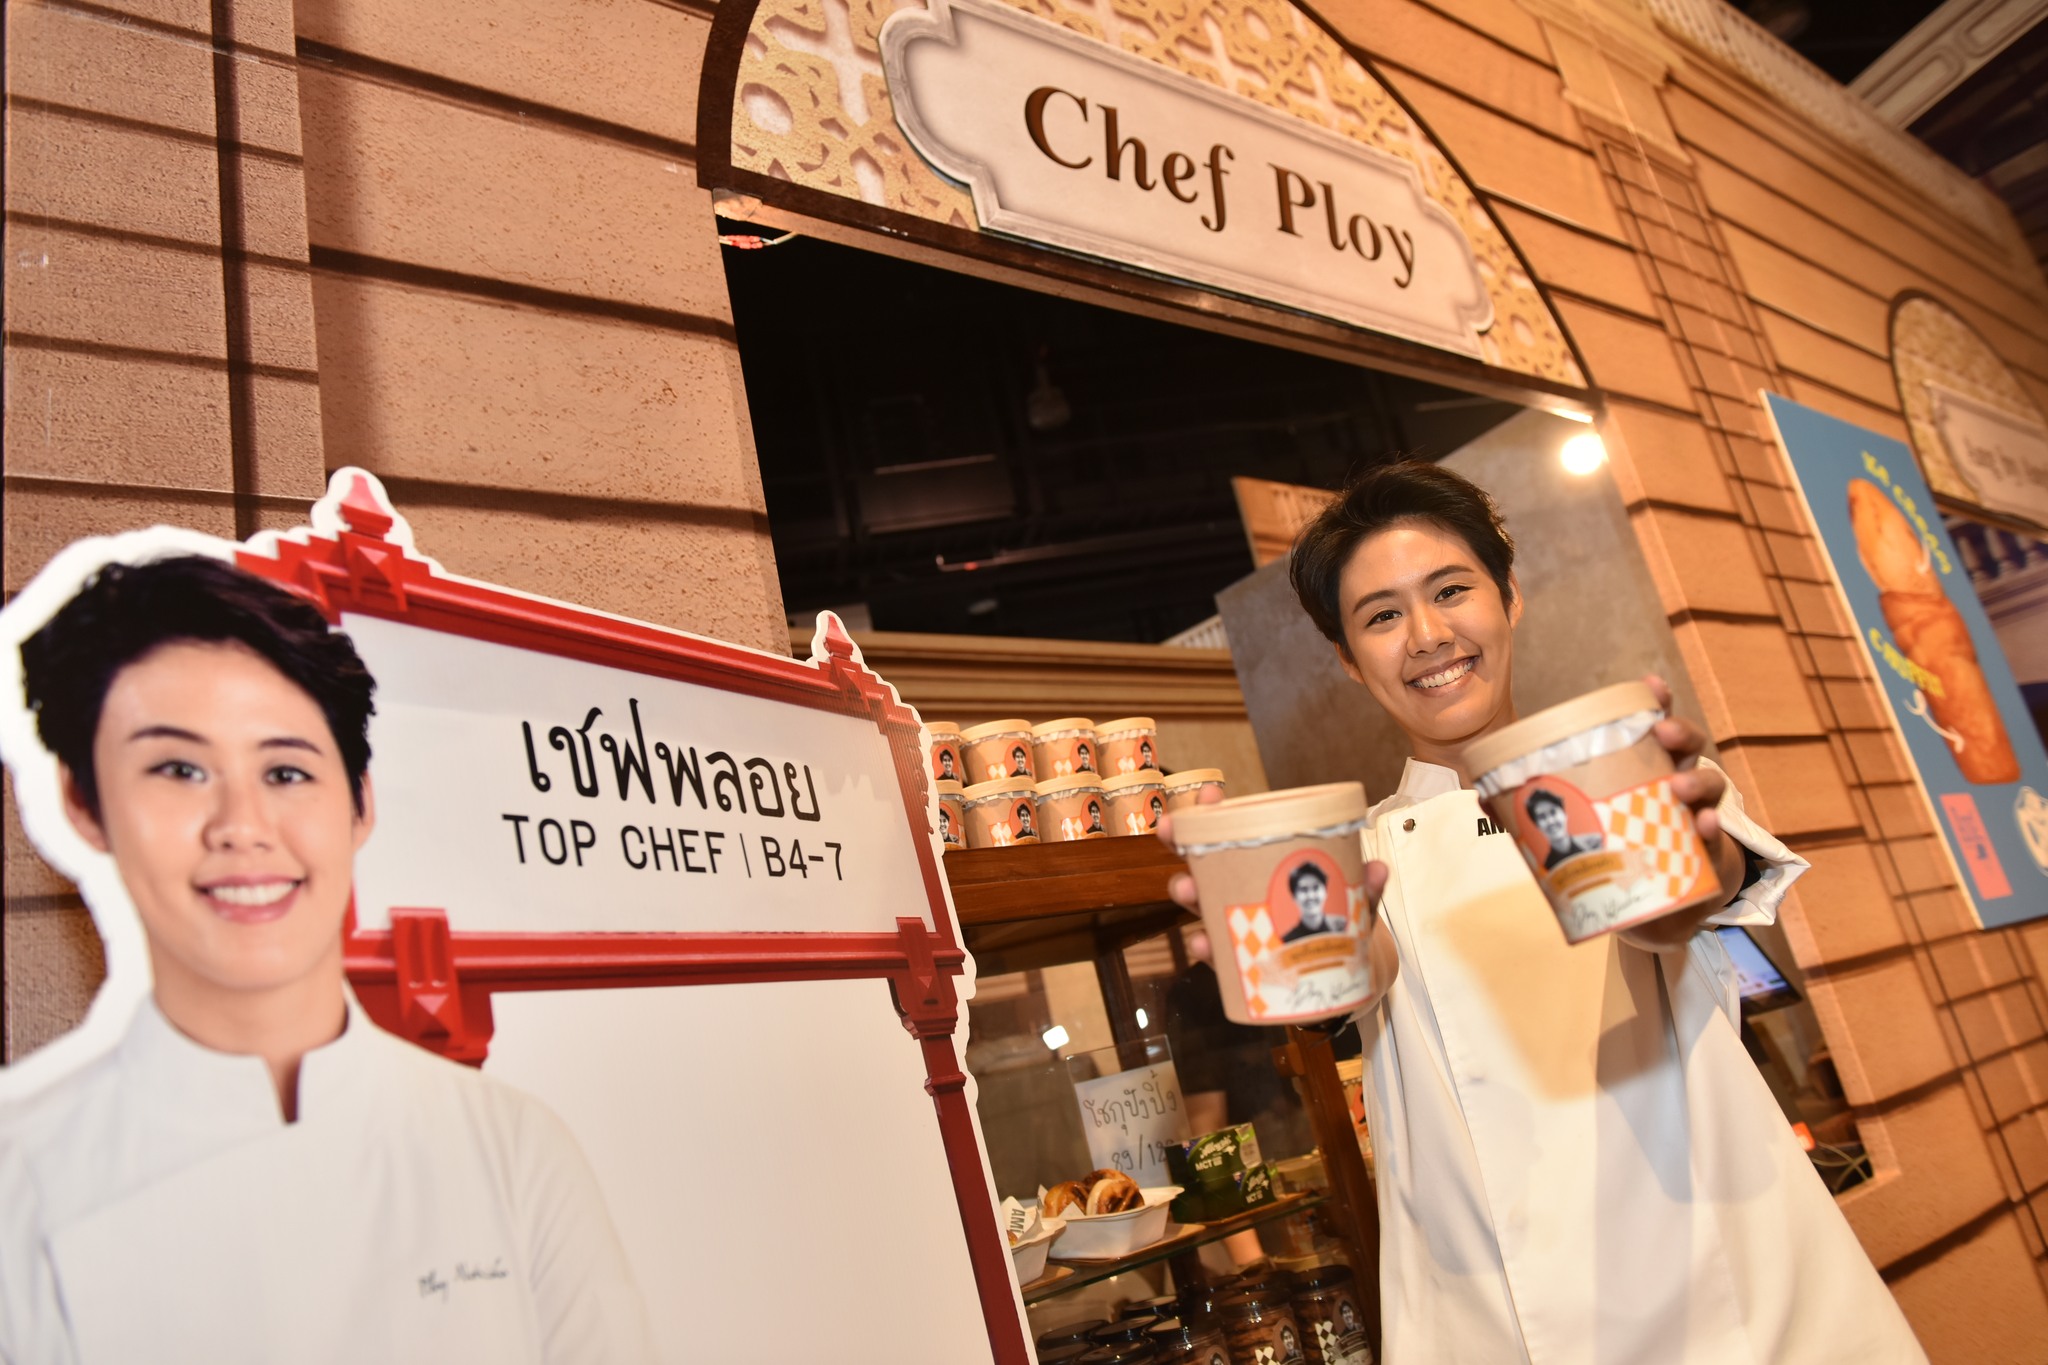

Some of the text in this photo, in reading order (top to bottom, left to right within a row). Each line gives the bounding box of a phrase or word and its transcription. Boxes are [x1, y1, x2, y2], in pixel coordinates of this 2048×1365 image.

[1023, 86, 1415, 289] Chef Ploy
[521, 697, 821, 823] เชฟพลอย
[501, 813, 843, 881] TOP CHEF B4-7
